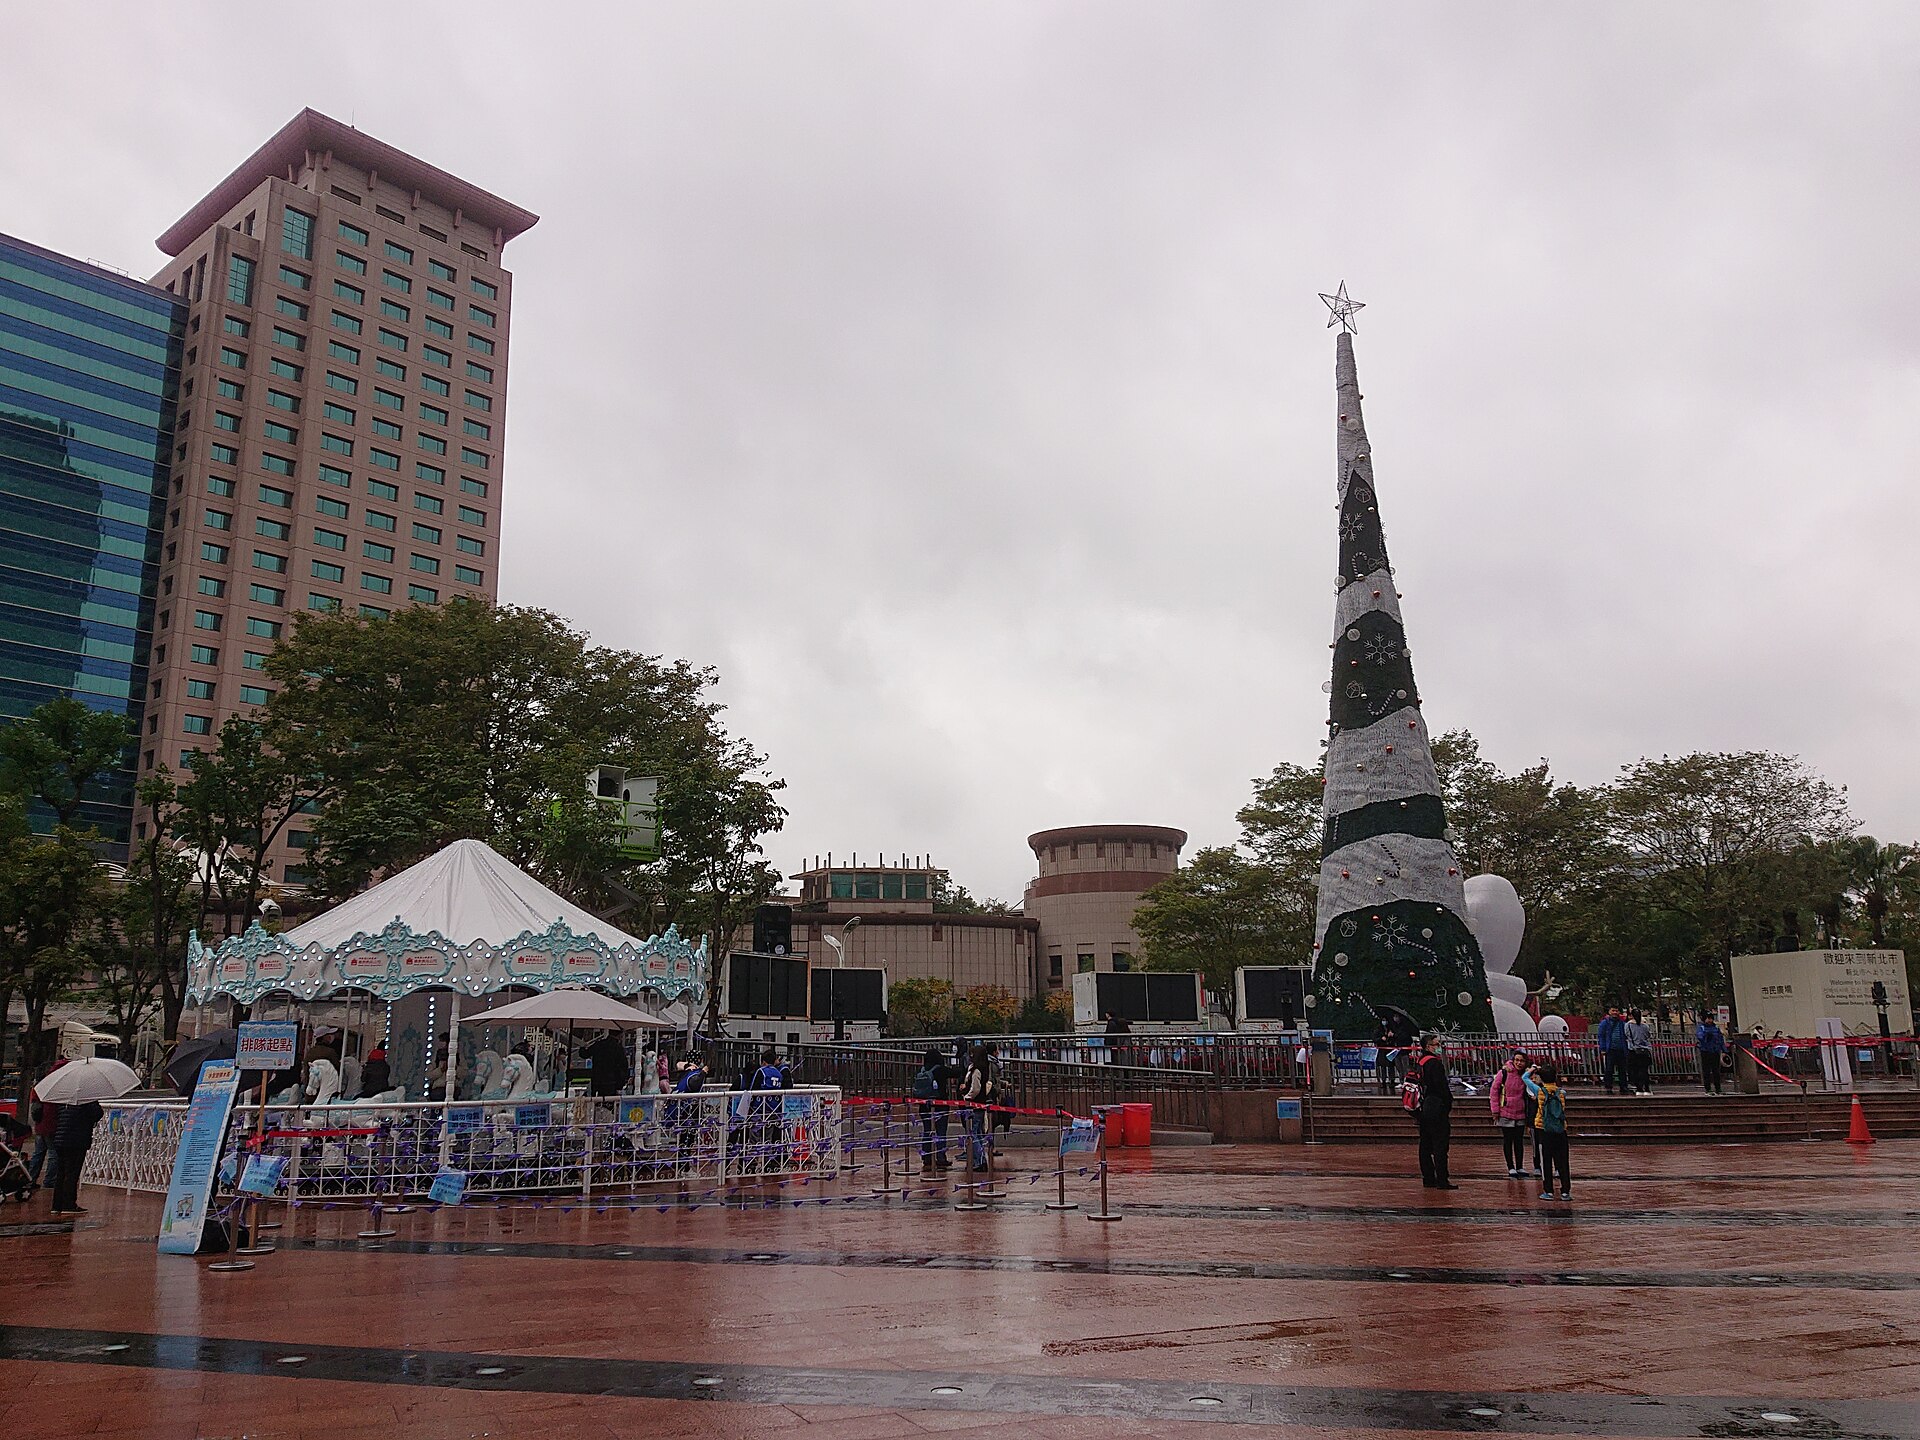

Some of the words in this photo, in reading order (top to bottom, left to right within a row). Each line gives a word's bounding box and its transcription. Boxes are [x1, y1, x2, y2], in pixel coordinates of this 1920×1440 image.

[1823, 953, 1899, 965] 歡迎來到新北市
[1845, 968, 1897, 976] 新北市へようこそ
[1761, 985, 1793, 995] 市民廣場
[240, 1037, 293, 1052] 排隊起點
